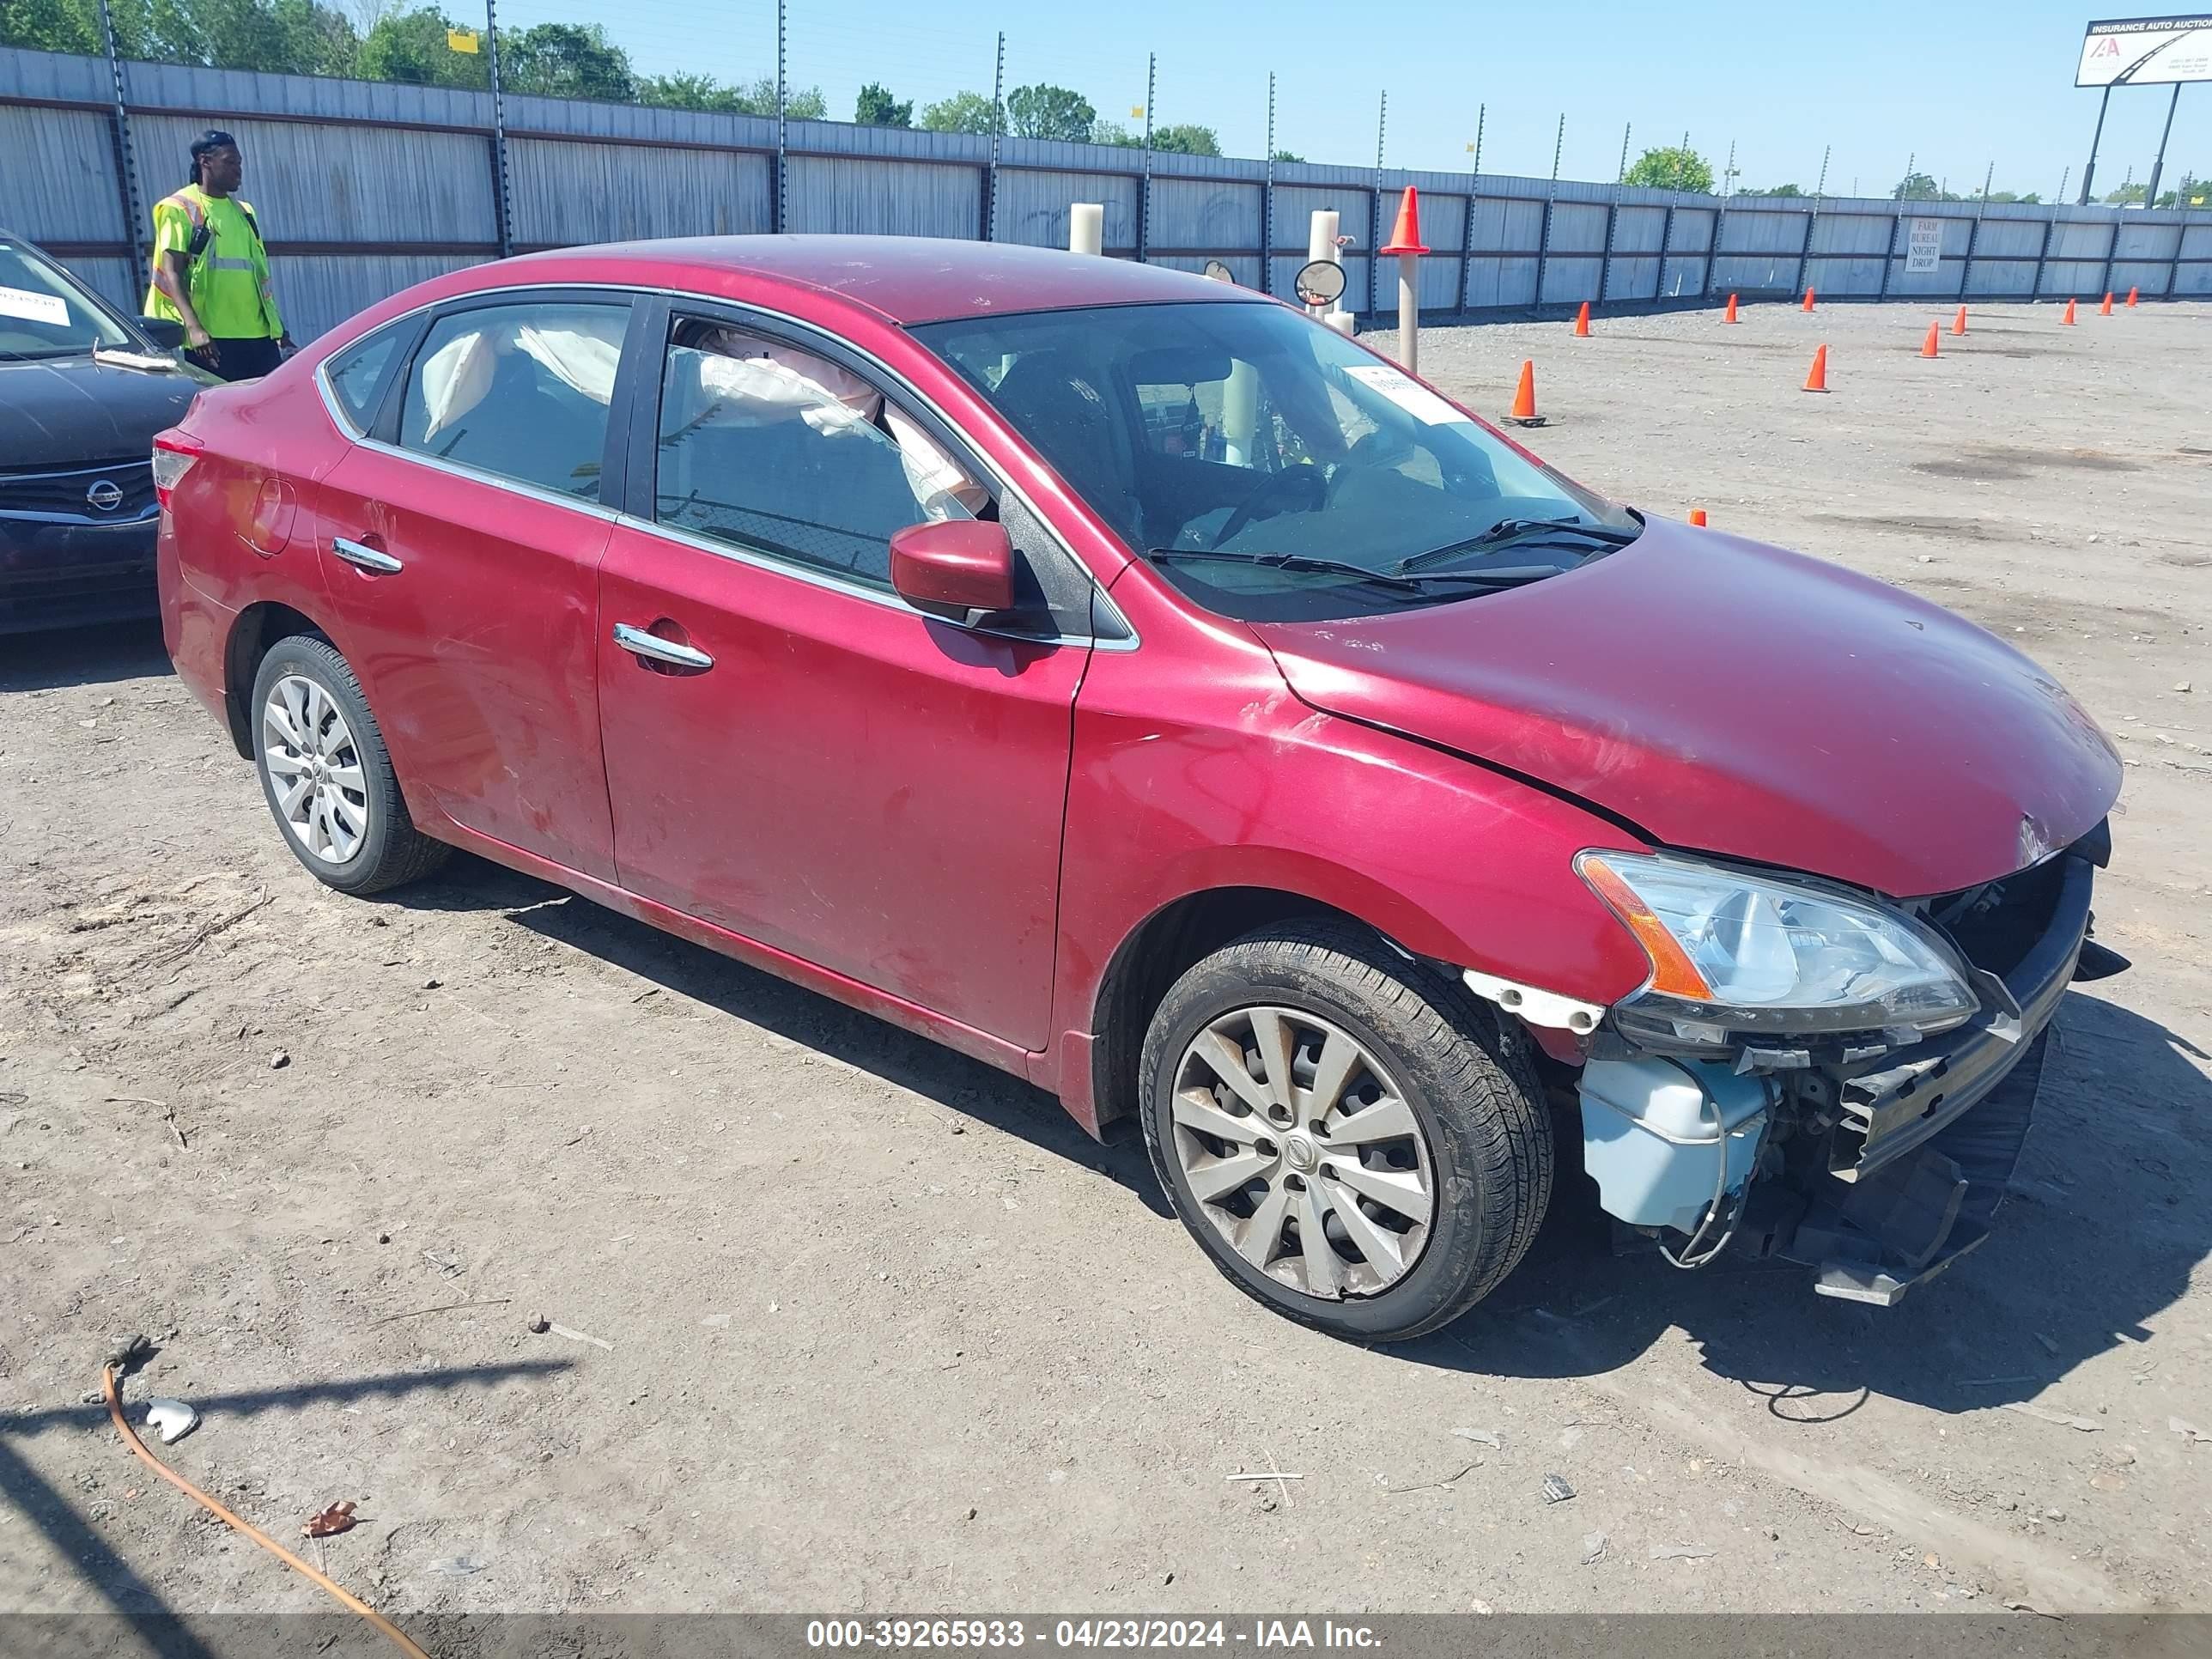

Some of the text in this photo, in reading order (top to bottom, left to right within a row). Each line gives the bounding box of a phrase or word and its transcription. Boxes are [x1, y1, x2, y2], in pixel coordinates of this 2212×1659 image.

[2092, 22, 2145, 33] INSURANCE
[2147, 21, 2172, 30] AUTO
[1917, 221, 1938, 231] FARM
[1911, 233, 1938, 243] BUREAU
[1911, 246, 1937, 256] NIGHT
[1911, 258, 1935, 267] DROP
